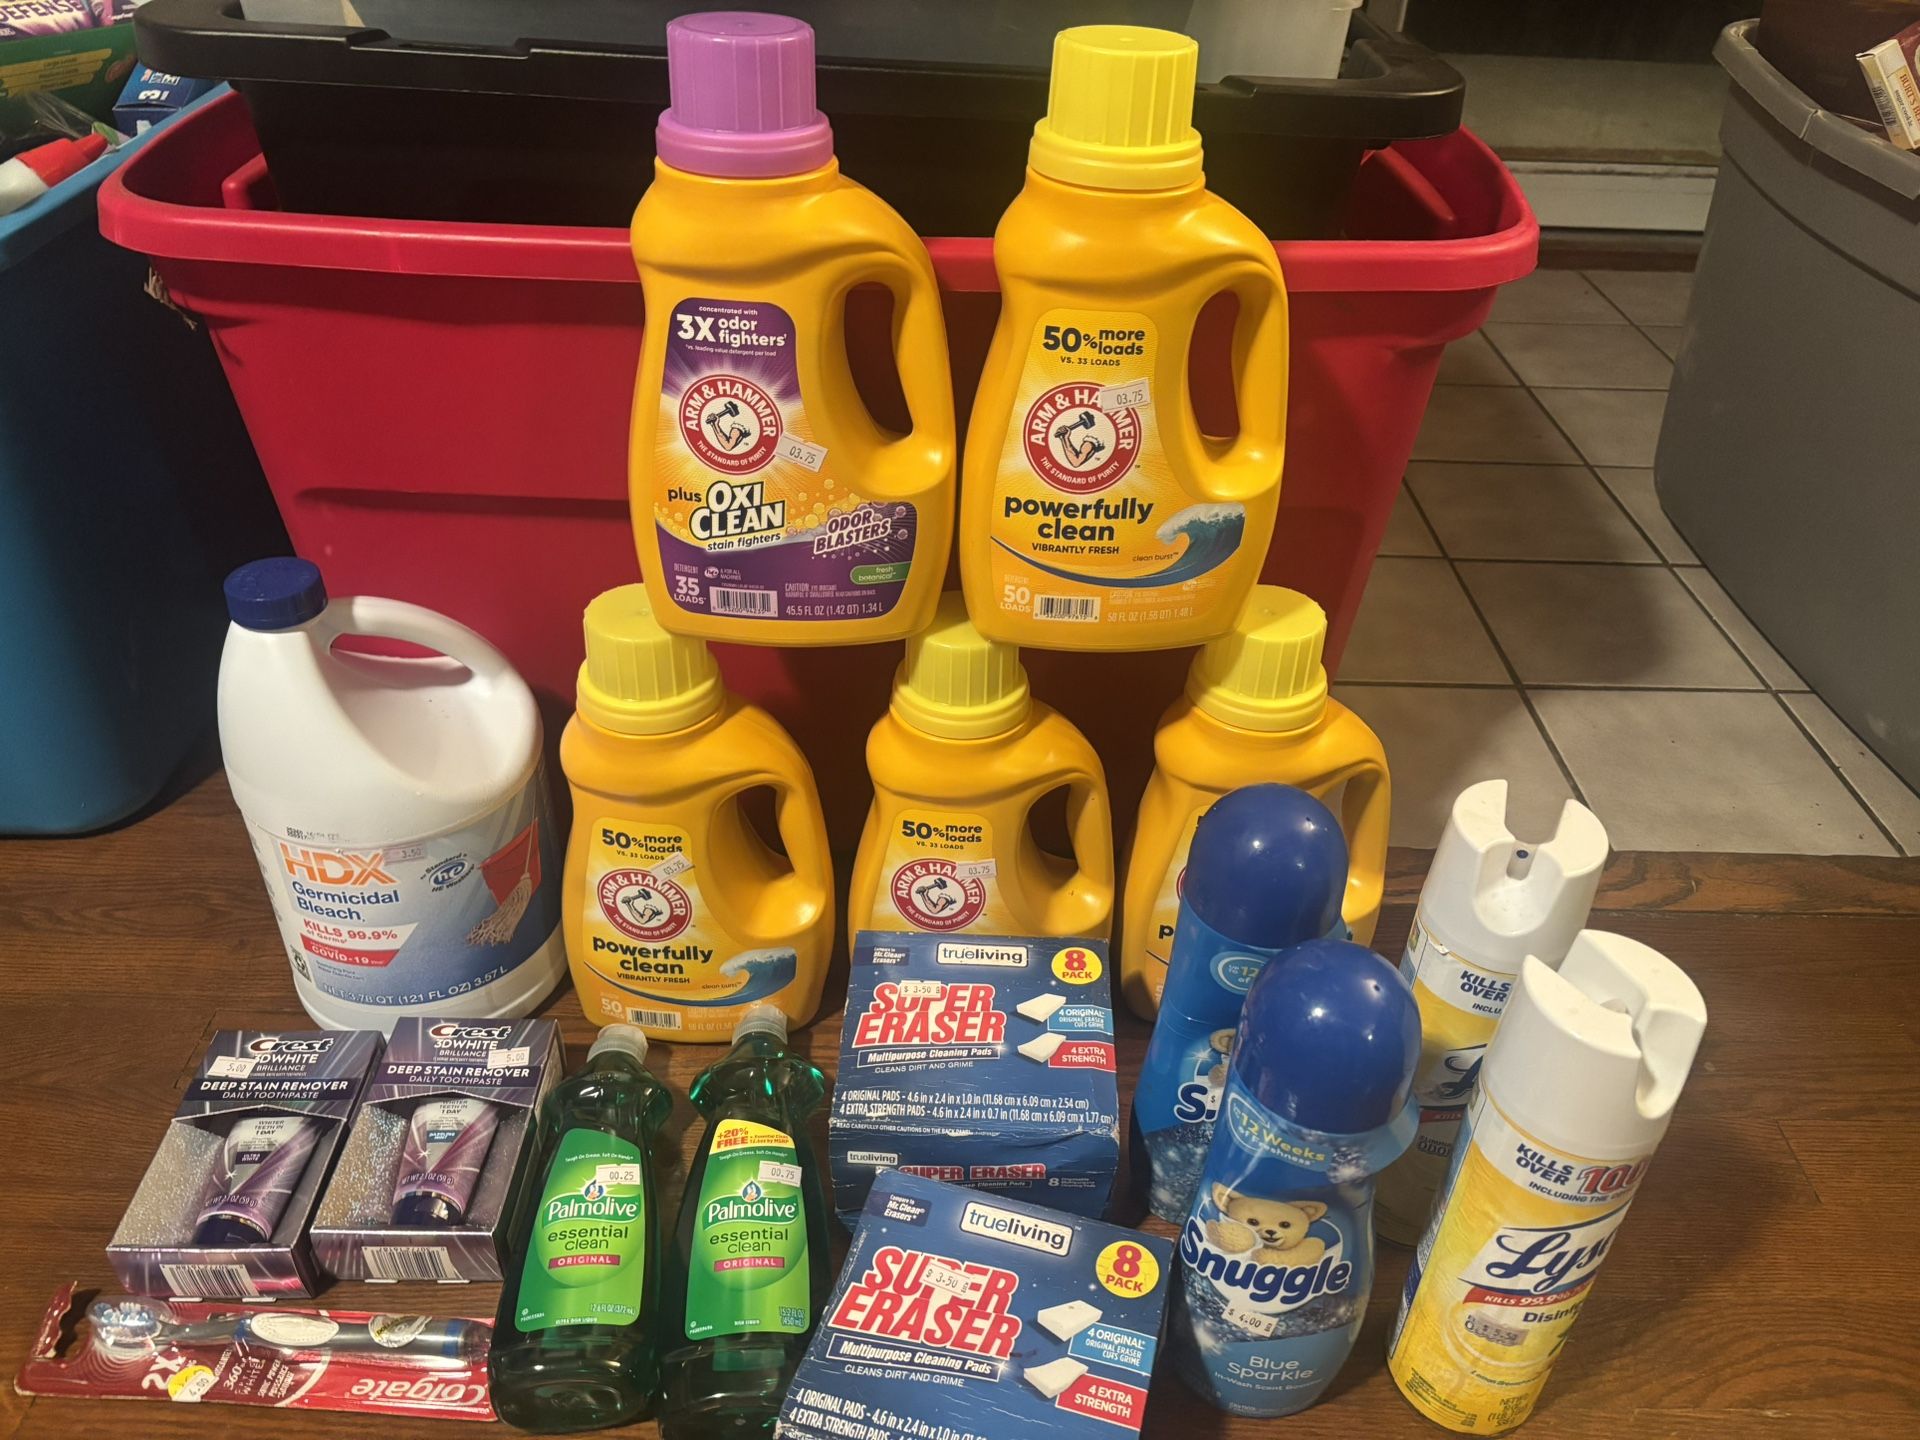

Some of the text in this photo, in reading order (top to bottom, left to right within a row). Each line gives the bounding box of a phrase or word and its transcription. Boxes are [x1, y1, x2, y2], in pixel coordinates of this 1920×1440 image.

[698, 305, 742, 315] concentrated
[676, 314, 716, 342] 3X
[718, 316, 758, 331] odor
[1042, 325, 1146, 353] 50% more
[1098, 342, 1144, 356] loads
[1116, 389, 1144, 406] 03.75
[685, 381, 777, 438] ARM & HAMMER
[789, 446, 817, 464] 03.75
[667, 487, 702, 503] plus
[708, 481, 763, 511] OXI
[1004, 496, 1154, 524] powerfully
[691, 502, 784, 539] CLEAN
[827, 508, 874, 533] ODOR
[814, 518, 891, 554] BLASTERS
[1037, 518, 1115, 542] clean
[707, 532, 781, 552] stain fighters
[1031, 542, 1120, 555] VIBRANTLY FRESH
[675, 575, 700, 597] 35
[786, 602, 884, 617] 45.5 FL OZ (1.42 QT) 1.34 L
[901, 819, 983, 839] 50% more
[945, 833, 982, 843] loads
[602, 828, 682, 850] 50% more
[644, 843, 683, 853] loads
[401, 849, 421, 859] 3.50
[280, 842, 398, 886] HDX
[663, 860, 685, 875] 03.75
[968, 865, 990, 876] 03.75
[292, 881, 400, 905] Germicidal
[602, 873, 686, 916] ARM & HAMMER
[303, 918, 398, 941] KILLS 99.9%
[311, 945, 369, 964] COVID-19
[592, 936, 714, 964] powerfully
[619, 957, 684, 975] clean
[1064, 949, 1087, 970] 8
[616, 972, 690, 984] VIBRANTLY FRESH
[1062, 970, 1093, 979] PACK
[1460, 970, 1513, 992] KILLS
[376, 995, 394, 1004] QT
[398, 993, 424, 1005] (121
[428, 990, 445, 1001] FL
[448, 981, 472, 995] OZ)
[474, 969, 498, 987] 3.57
[500, 965, 508, 975] L
[913, 986, 931, 994] 3.50
[1460, 982, 1508, 1002] OVER
[870, 982, 995, 1012] SUPER
[429, 1023, 512, 1039] Crest
[853, 1011, 1006, 1046] ERASER
[250, 1037, 334, 1052] Crest
[439, 1049, 487, 1058] BRILLIANCE
[1078, 1046, 1106, 1056] EXTRA
[506, 1052, 525, 1063] 5.00
[866, 1047, 992, 1063] Multipurpose Cleaning Pads
[1061, 1054, 1106, 1065] STRENGTH
[226, 1063, 247, 1073] 5.00
[256, 1064, 306, 1072] BRILLIANCE
[387, 1065, 530, 1078] DEEP STAIN REMOVER
[874, 1061, 973, 1074] CLEANS DIRT AND GRIME
[200, 1080, 348, 1091] DEEP STAIN REMOVER
[408, 1075, 502, 1086] DAILY TOOTHPASTE
[222, 1091, 319, 1099] DAILY TOOTHPASTE
[717, 1136, 749, 1149] FREE
[1241, 1111, 1326, 1161] 12 Weeks
[1516, 1143, 1575, 1176] KILLS
[609, 1171, 634, 1180] 00.25
[771, 1167, 795, 1180] 00.75
[969, 1163, 1047, 1180] ERASER
[1515, 1156, 1572, 1186] OVER
[1528, 1180, 1608, 1203] INCLUDING THE
[548, 1196, 637, 1221] Palmolive
[708, 1198, 795, 1223] Palmolive
[547, 1225, 628, 1242] essential
[709, 1227, 789, 1245] essential
[970, 1208, 1066, 1250] trueliving
[564, 1238, 609, 1251] clean
[727, 1241, 771, 1254] clean
[557, 1255, 612, 1266] ORIGINAL
[723, 1258, 777, 1269] ORIGINAL
[1111, 1244, 1143, 1278] 8
[1180, 1216, 1352, 1305] Snuggle
[926, 1268, 958, 1289] $ 3.50
[1104, 1275, 1145, 1293] PACK
[1484, 1295, 1517, 1305] KILLS
[831, 1282, 1022, 1360] ERASER
[1227, 1308, 1262, 1328] $ 4.00
[840, 1340, 992, 1375] Multipurpose Cleaning Pads
[1248, 1355, 1300, 1370] Blue
[844, 1364, 965, 1387] CLEANS DIRT AND GRIME
[1226, 1361, 1314, 1381] Sparkle
[351, 1376, 486, 1406] Colgate
[1088, 1384, 1133, 1406] 4 EXTRA
[1074, 1393, 1131, 1419] STRENGTH
